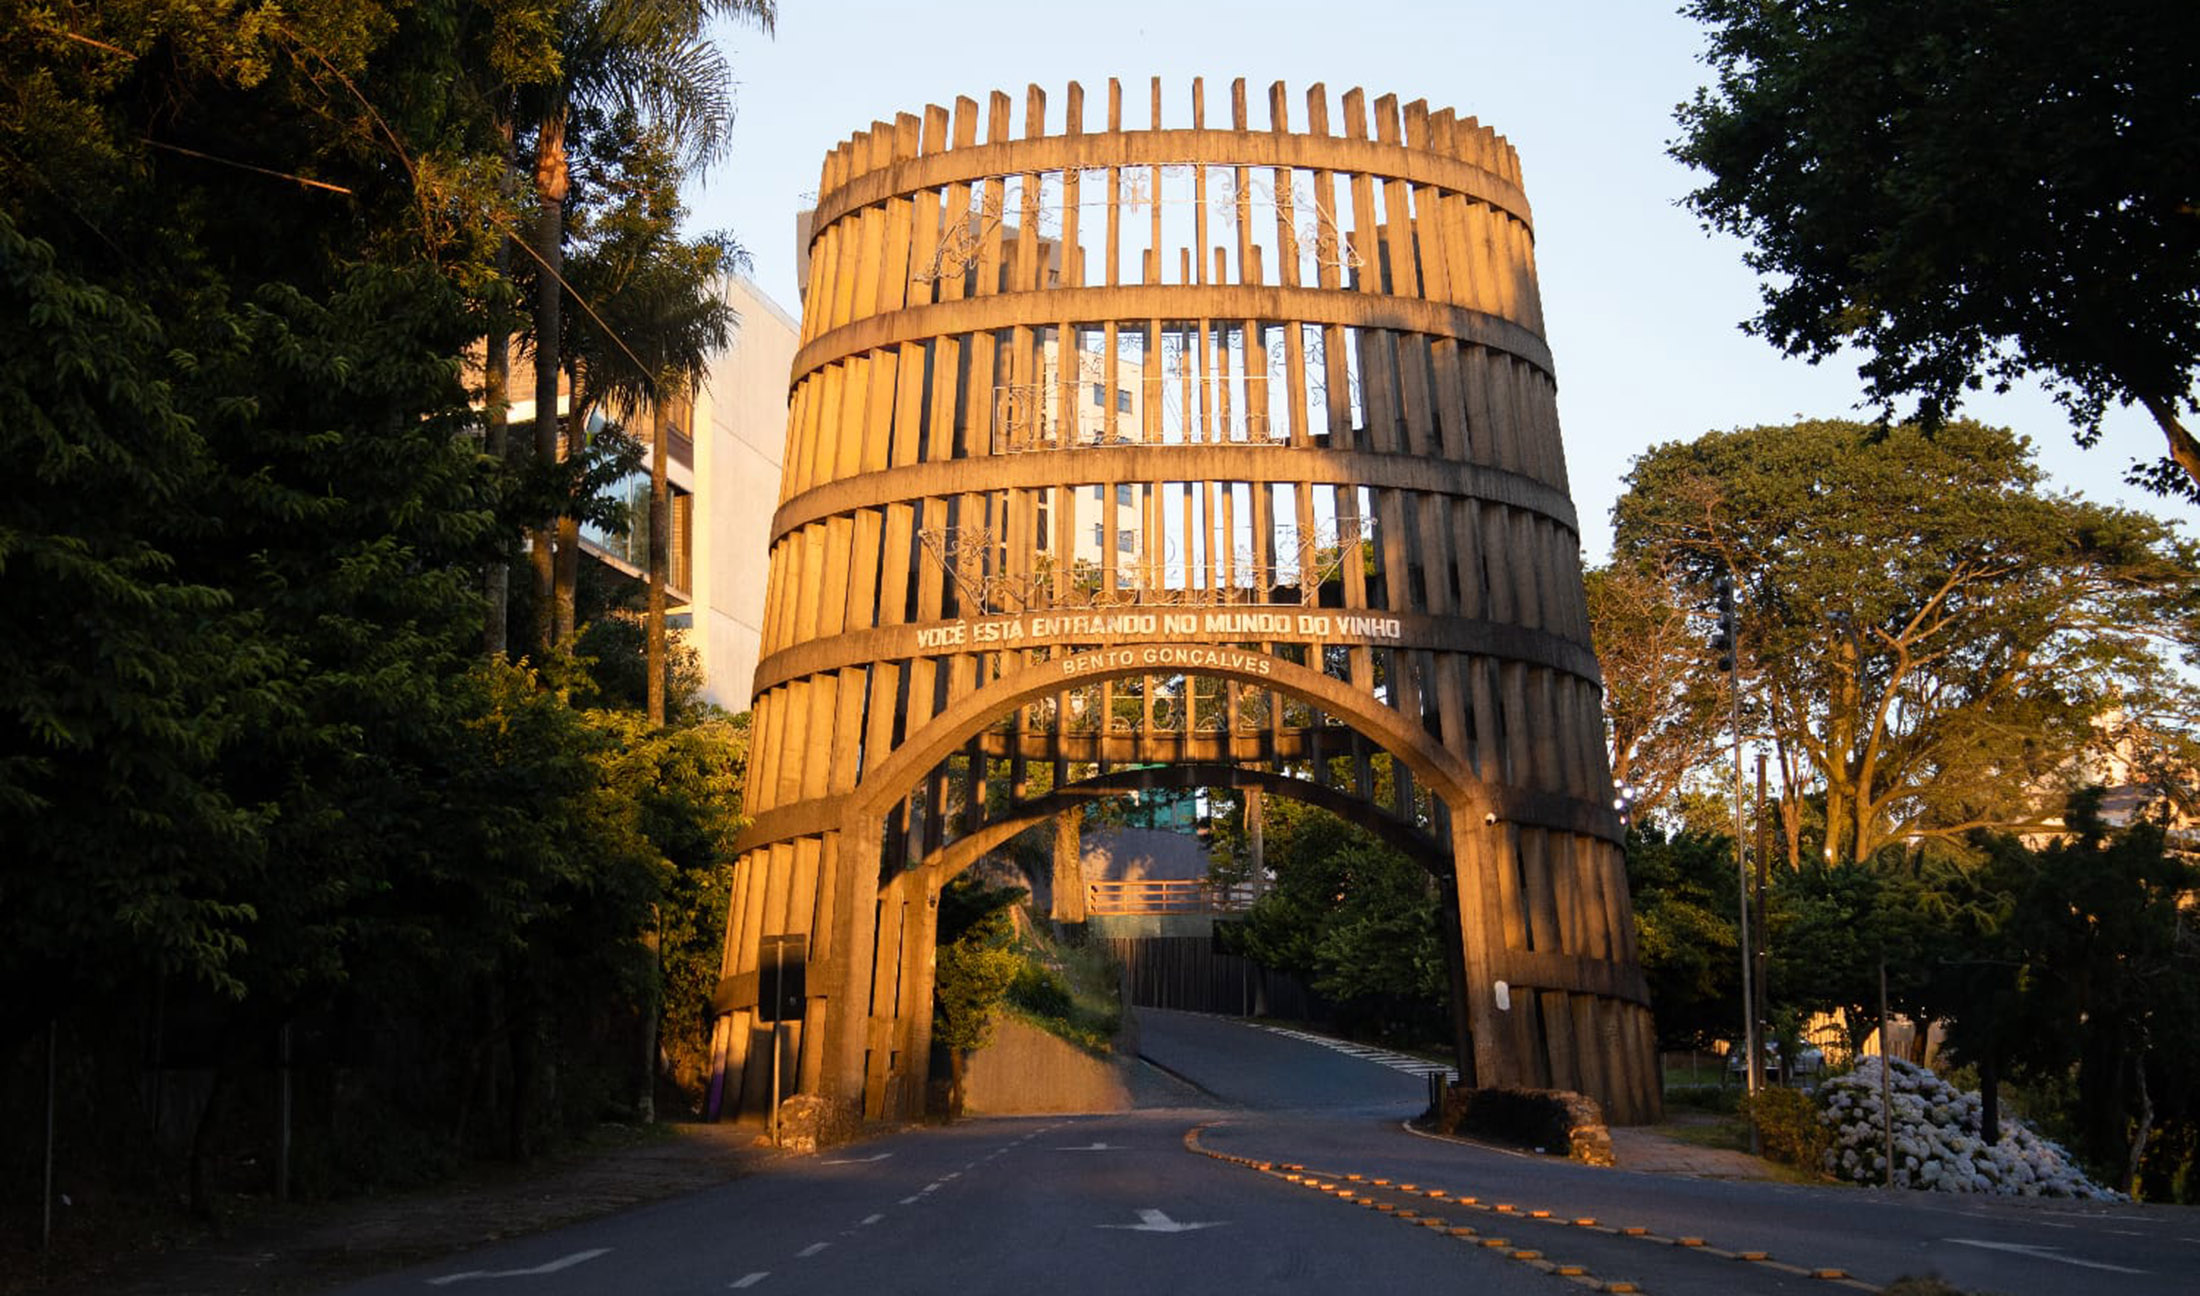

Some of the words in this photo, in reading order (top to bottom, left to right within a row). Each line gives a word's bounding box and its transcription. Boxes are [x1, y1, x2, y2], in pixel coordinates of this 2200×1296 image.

[917, 620, 966, 648] VOCÊ
[973, 615, 1024, 642] ESTÁ
[1032, 614, 1156, 637] ENTRANDO
[1164, 614, 1198, 634] NO
[1205, 613, 1291, 633] MUNDO
[1298, 615, 1330, 636] DO
[1336, 616, 1400, 639] VINHO
[1063, 650, 1134, 675] BENTO
[1143, 648, 1271, 675] GONÇALVES
